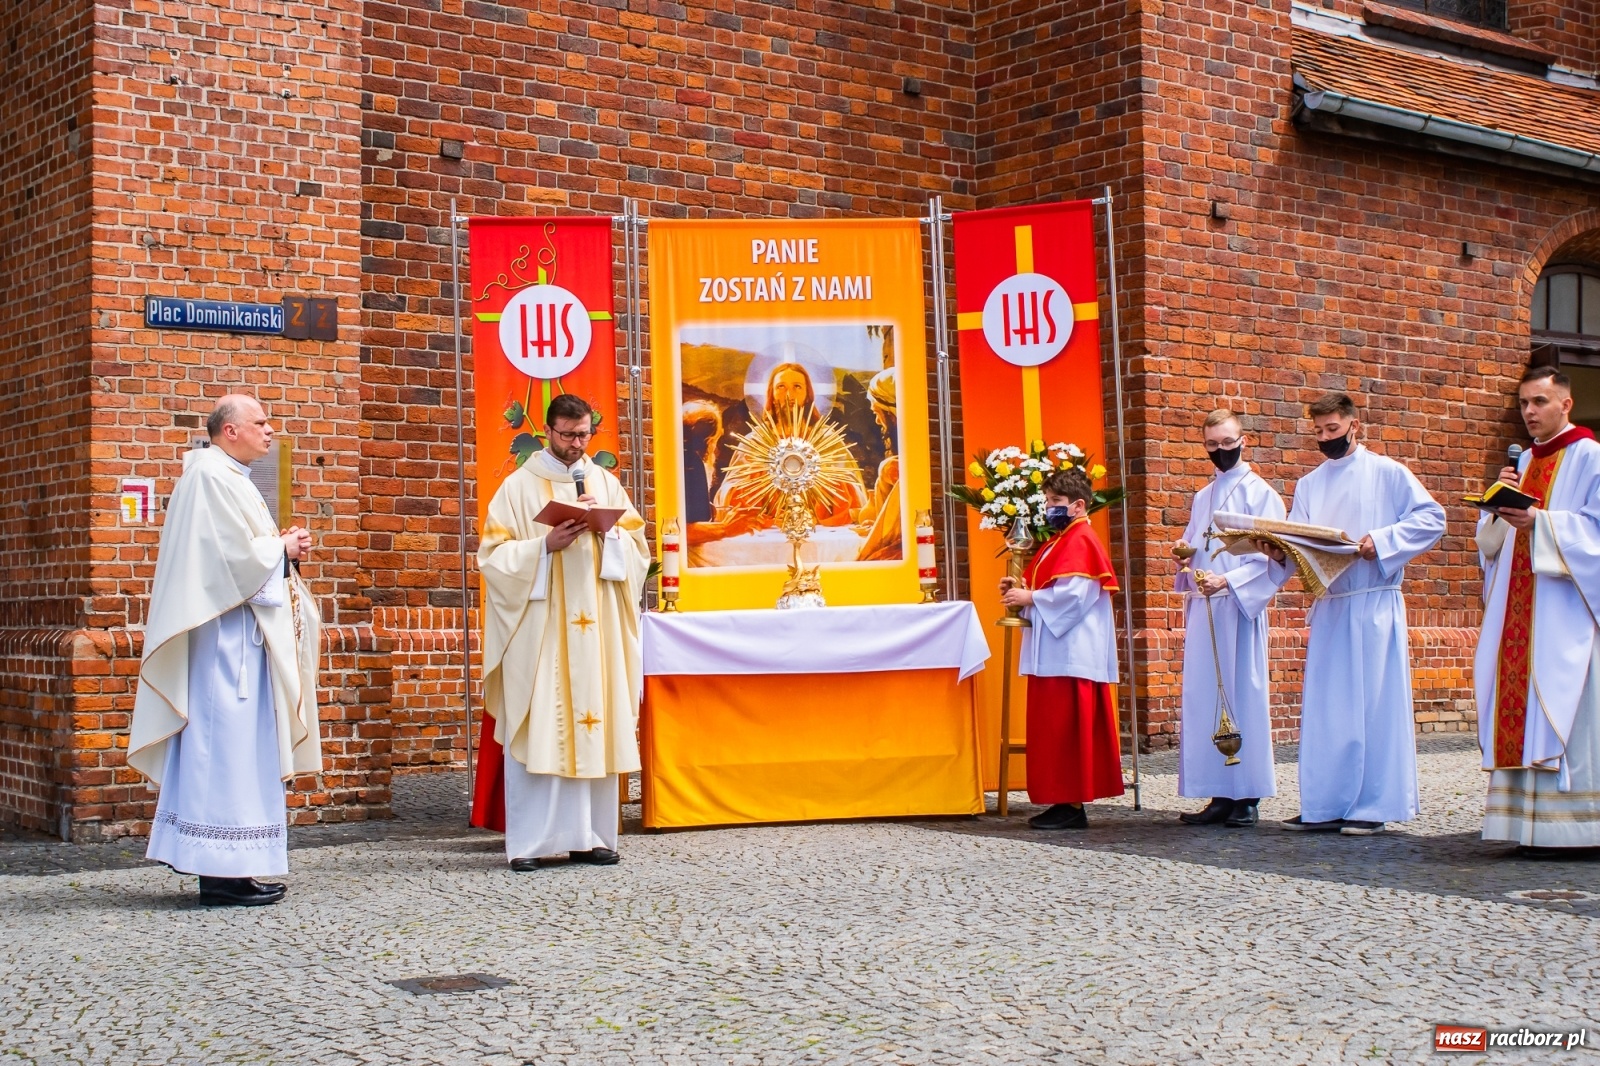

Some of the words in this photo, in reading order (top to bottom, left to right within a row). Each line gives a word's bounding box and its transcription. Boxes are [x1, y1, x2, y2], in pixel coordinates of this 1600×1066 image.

[751, 239, 819, 264] PANIE
[699, 272, 786, 302] ZOSTAŃ
[792, 276, 806, 301] Z
[811, 275, 872, 301] NAMI
[150, 299, 182, 323] Plac
[186, 301, 282, 329] Dominikański
[1002, 289, 1057, 347] IHS
[520, 303, 575, 358] IHS
